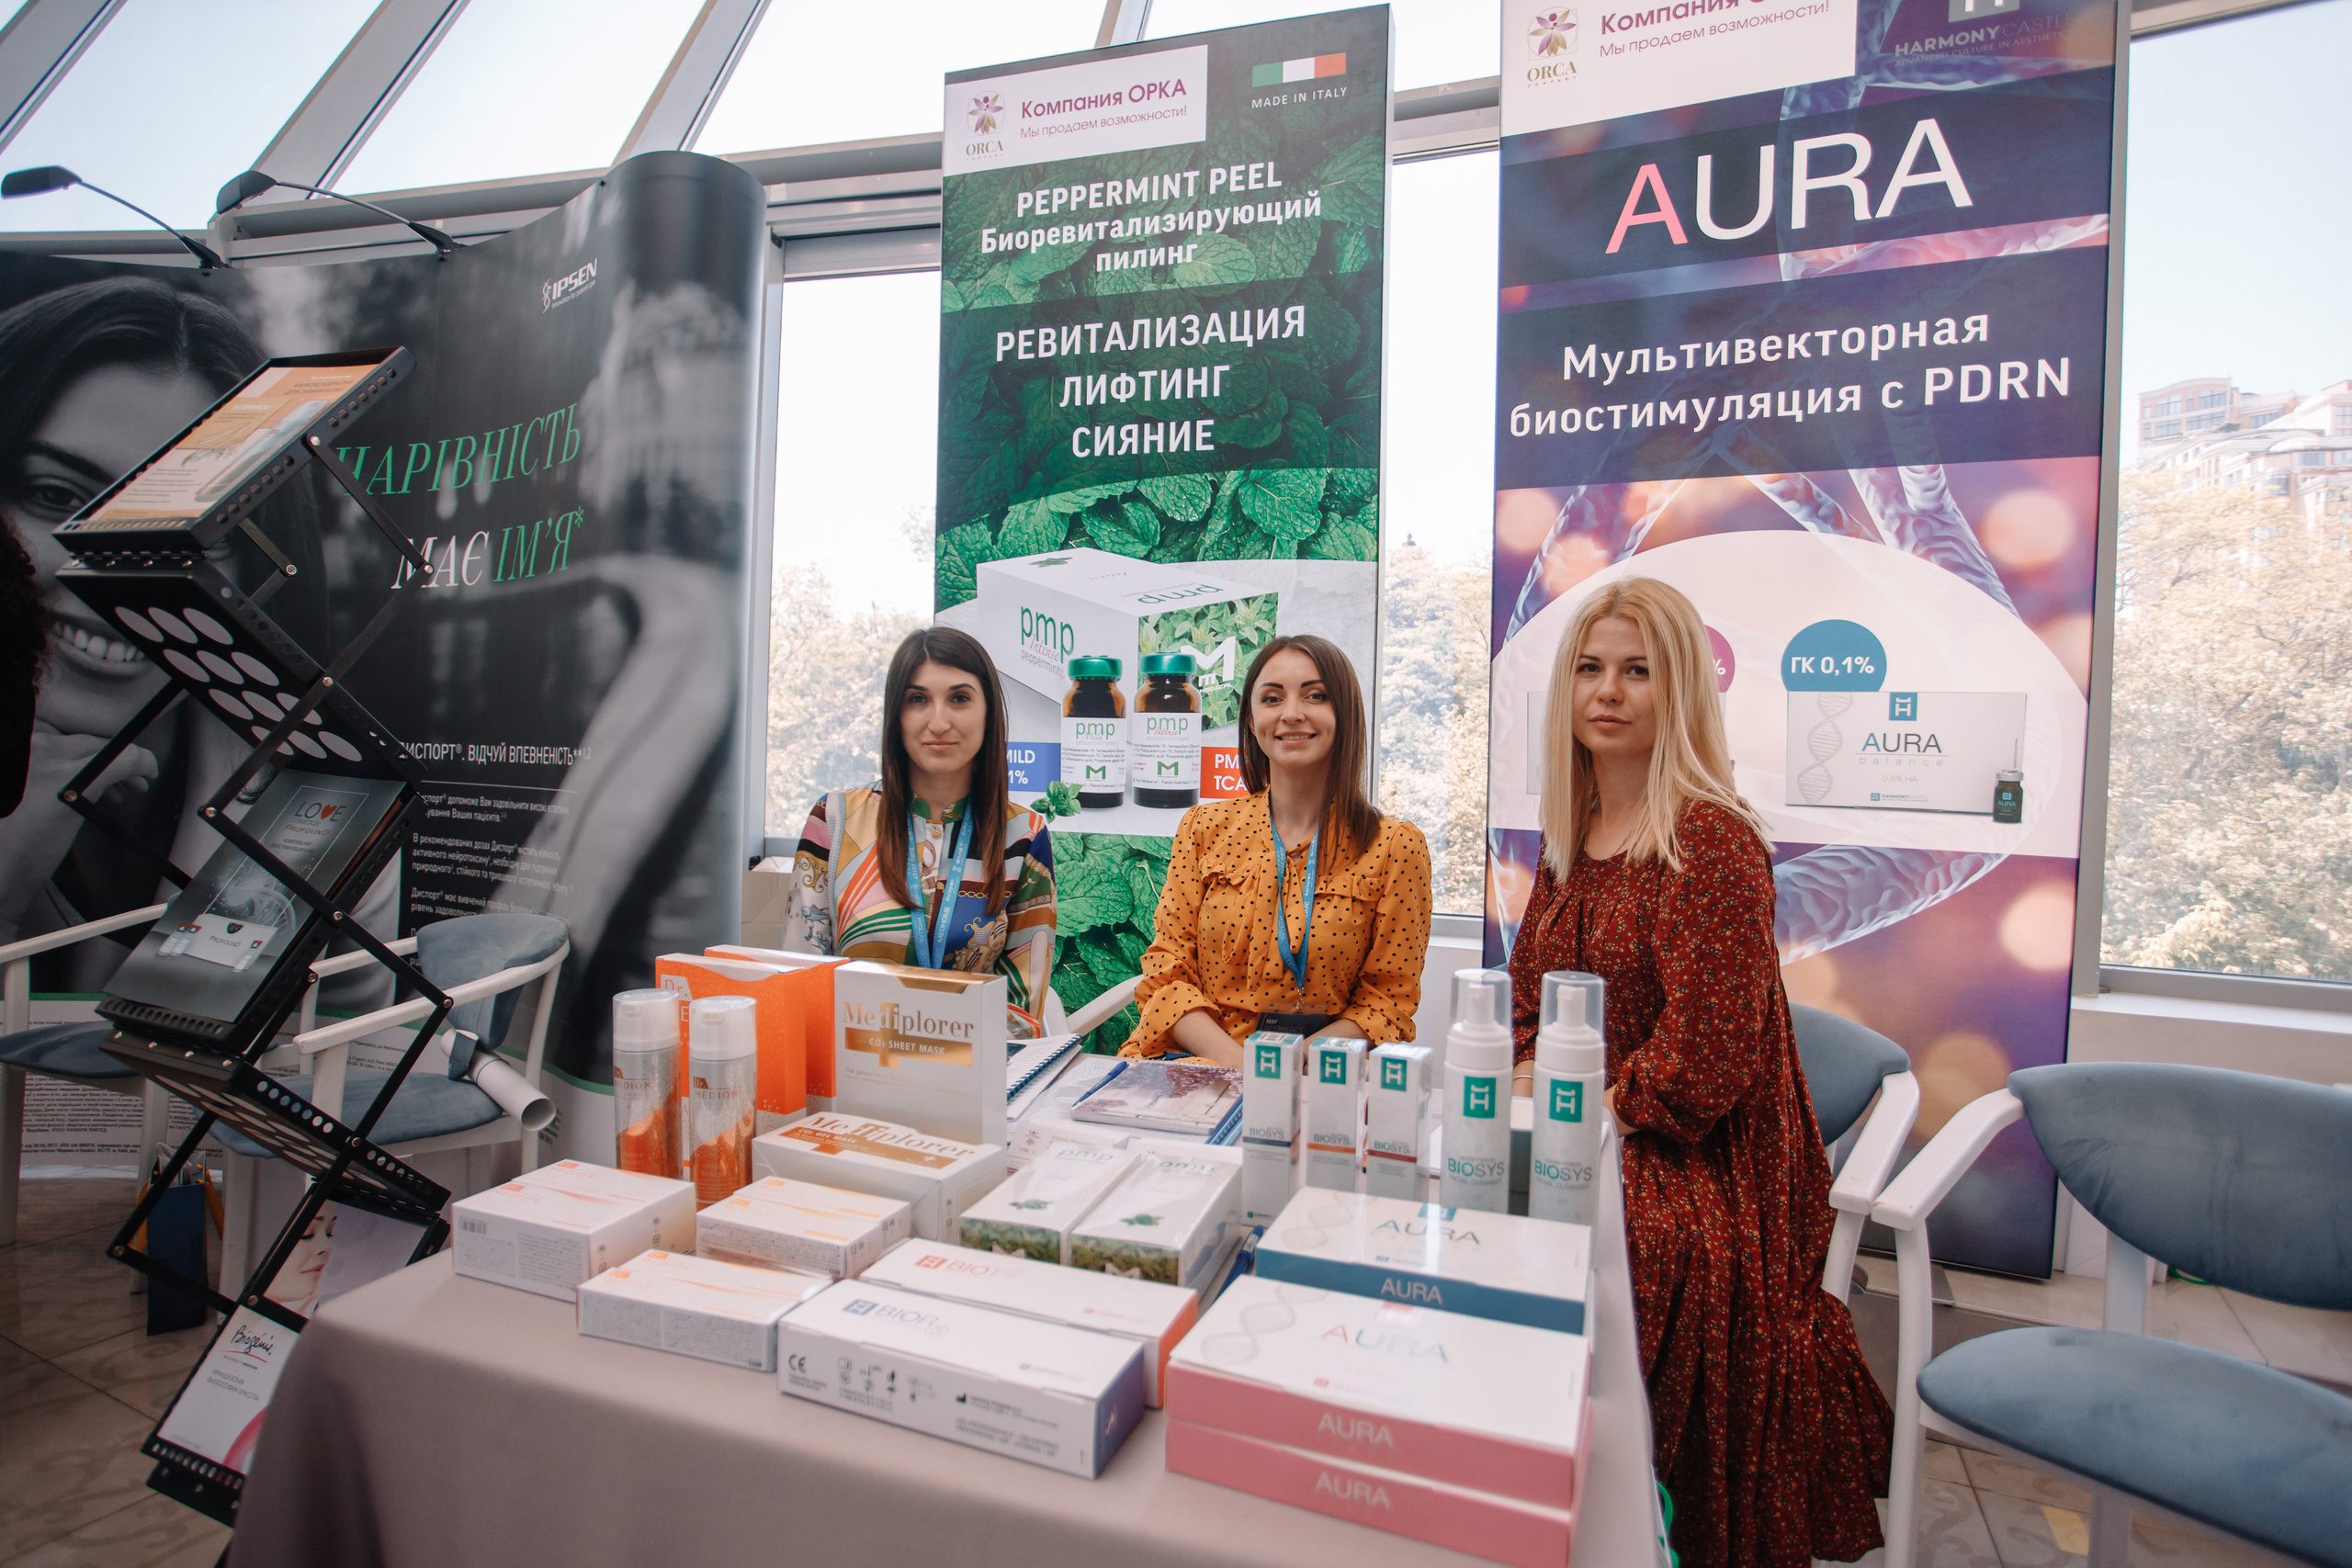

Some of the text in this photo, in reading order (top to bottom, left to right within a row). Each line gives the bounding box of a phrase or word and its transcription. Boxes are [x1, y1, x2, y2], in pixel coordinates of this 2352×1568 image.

[1600, 0, 1829, 58] Мы продаем возможности!
[1894, 51, 1950, 67] ADVANCED
[1951, 43, 1996, 57] CULTURE
[1998, 40, 2009, 49] IN
[1527, 61, 1577, 83] ORCA
[1528, 75, 1577, 88] COMPANY
[1022, 79, 1186, 118] Компания ОРКА
[1252, 86, 1348, 108] MADE IN ITALY
[1021, 105, 1187, 138] Мы продаем возможности!
[966, 140, 1003, 156] ORCA
[1016, 161, 1283, 218] PEPPERMINT PEEL
[1605, 118, 1973, 254] AURA
[981, 191, 1322, 254] Биоревитализирующий
[1096, 243, 1198, 273] пилинг
[552, 258, 597, 300] IPSEN
[996, 305, 1306, 362] РЕВИТАЛИЗАЦИЯ
[1563, 314, 1989, 386] Мультивекторная
[1060, 365, 1230, 408] ЛИФТИНГ
[1510, 357, 2070, 437] биостимуляция с PDRN
[1072, 420, 1215, 458] СИЯНИЕ
[390, 530, 490, 590] МАЄ
[1021, 606, 1074, 663] pmp
[1791, 656, 1875, 676] ГК 0,1%
[1076, 722, 1115, 740] pmp
[1148, 717, 1188, 735] pmp
[468, 742, 506, 764] ВІДЧУЙ
[1861, 732, 1942, 753] AURA
[1215, 753, 1240, 769] PM
[1859, 756, 1943, 767] balance
[1214, 775, 1248, 791] TCA
[447, 796, 479, 805] допоможе
[480, 796, 492, 807] Вам
[452, 808, 473, 819] Ваших
[284, 824, 330, 836] PROFOUND
[420, 836, 473, 848] рекомендованих
[473, 841, 491, 850] дозах
[413, 849, 447, 859] активного
[411, 903, 434, 913] рівень
[445, 894, 457, 903] має
[458, 896, 487, 908] вивчений
[937, 906, 951, 943] MEDHOME
[665, 979, 688, 997] Dr.
[888, 1040, 916, 1052] SHEET
[919, 1044, 945, 1055] MASK
[694, 1090, 739, 1100] MEDION
[833, 1135, 857, 1145] MASK
[1250, 1128, 1284, 1139] BIOSYS
[1314, 1134, 1350, 1145] BIOSYS
[1057, 1149, 1114, 1162] pmp
[1374, 1141, 1410, 1154] BIOSYS
[1448, 1157, 1505, 1178] BIOSYS
[1534, 1159, 1592, 1182] BIOSYS
[1381, 1278, 1442, 1304] AURA
[1317, 1413, 1394, 1449] AURA
[1316, 1472, 1392, 1510] AURA
